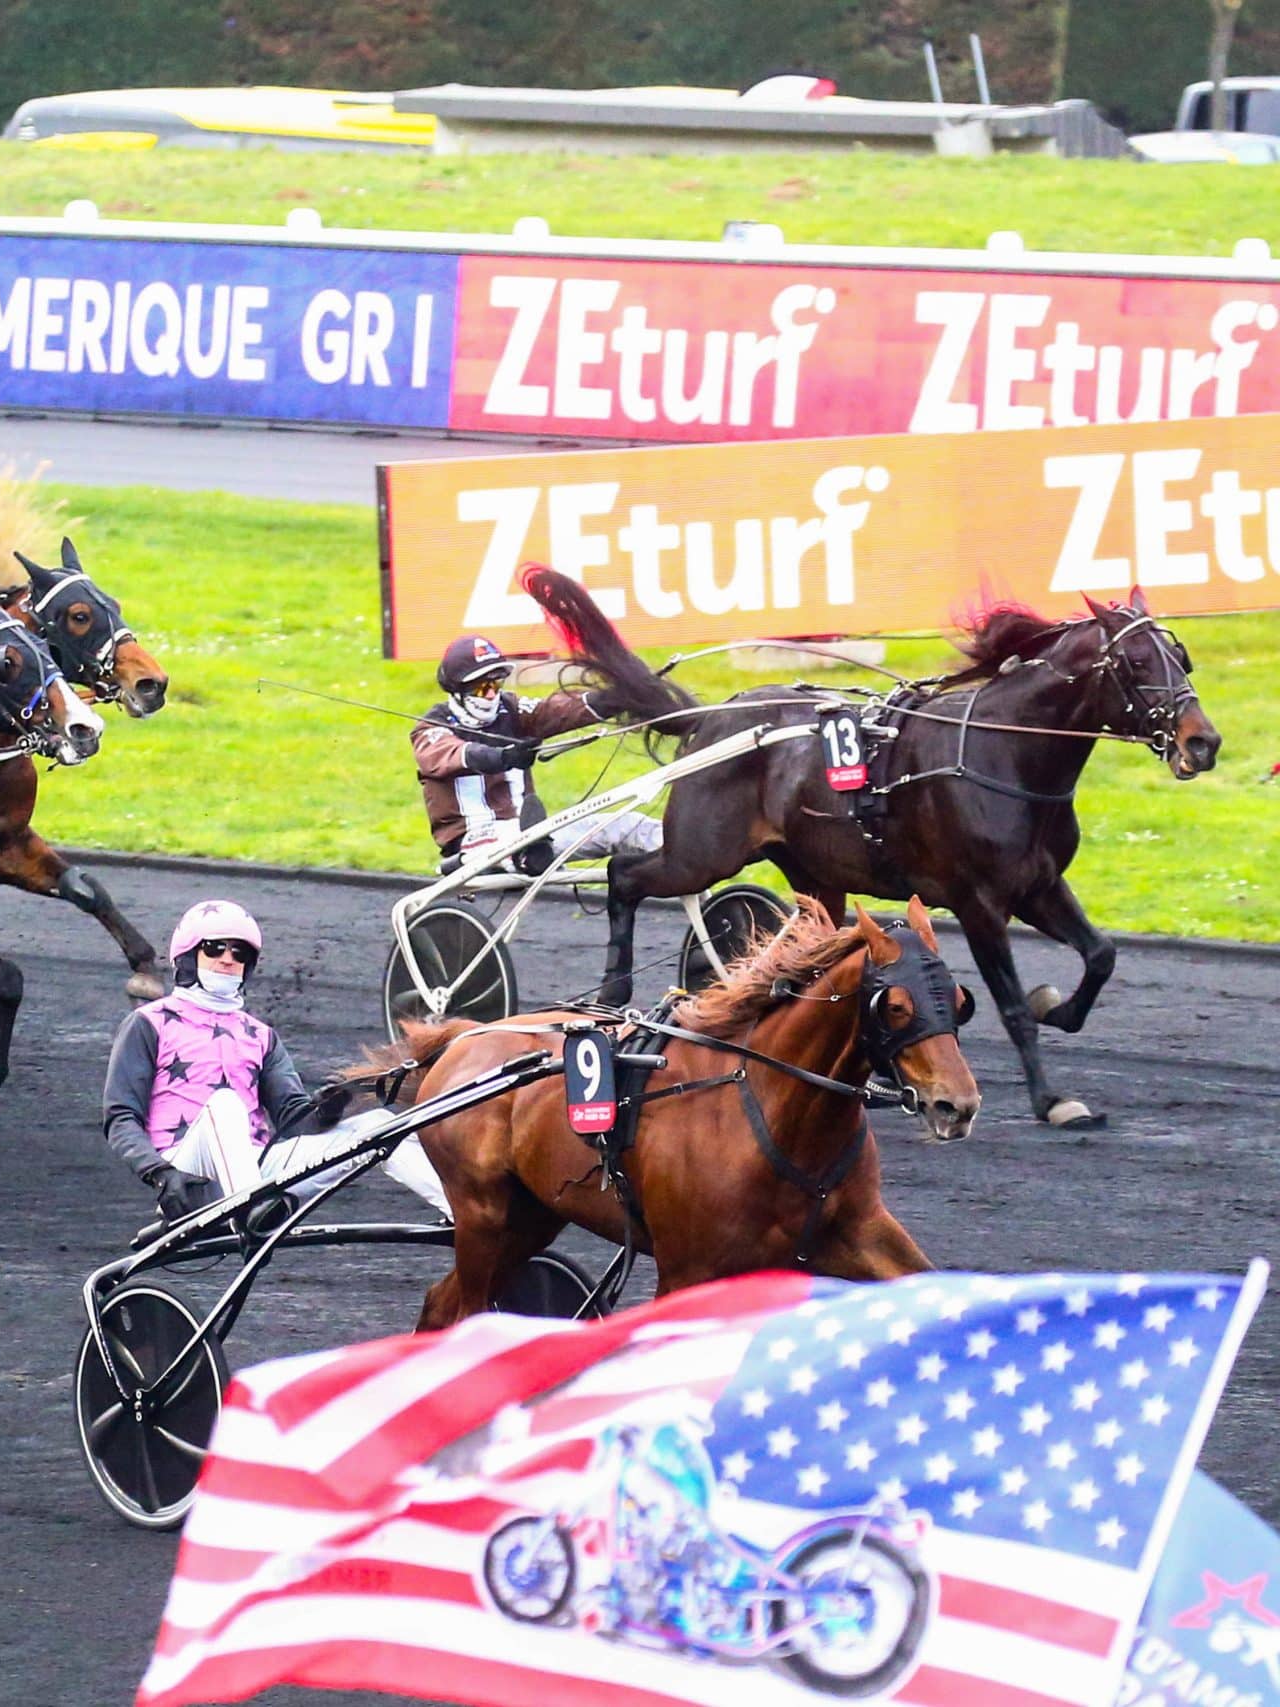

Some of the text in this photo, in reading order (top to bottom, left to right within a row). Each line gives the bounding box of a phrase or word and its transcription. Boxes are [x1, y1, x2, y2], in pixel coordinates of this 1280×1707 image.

[302, 289, 395, 387] GR
[483, 275, 837, 428] ZEturf
[908, 291, 1279, 434] ZEturf
[458, 466, 890, 629] ZEturf
[1043, 448, 1280, 593] ZEt
[822, 717, 860, 768] 13
[576, 1038, 601, 1102] 9
